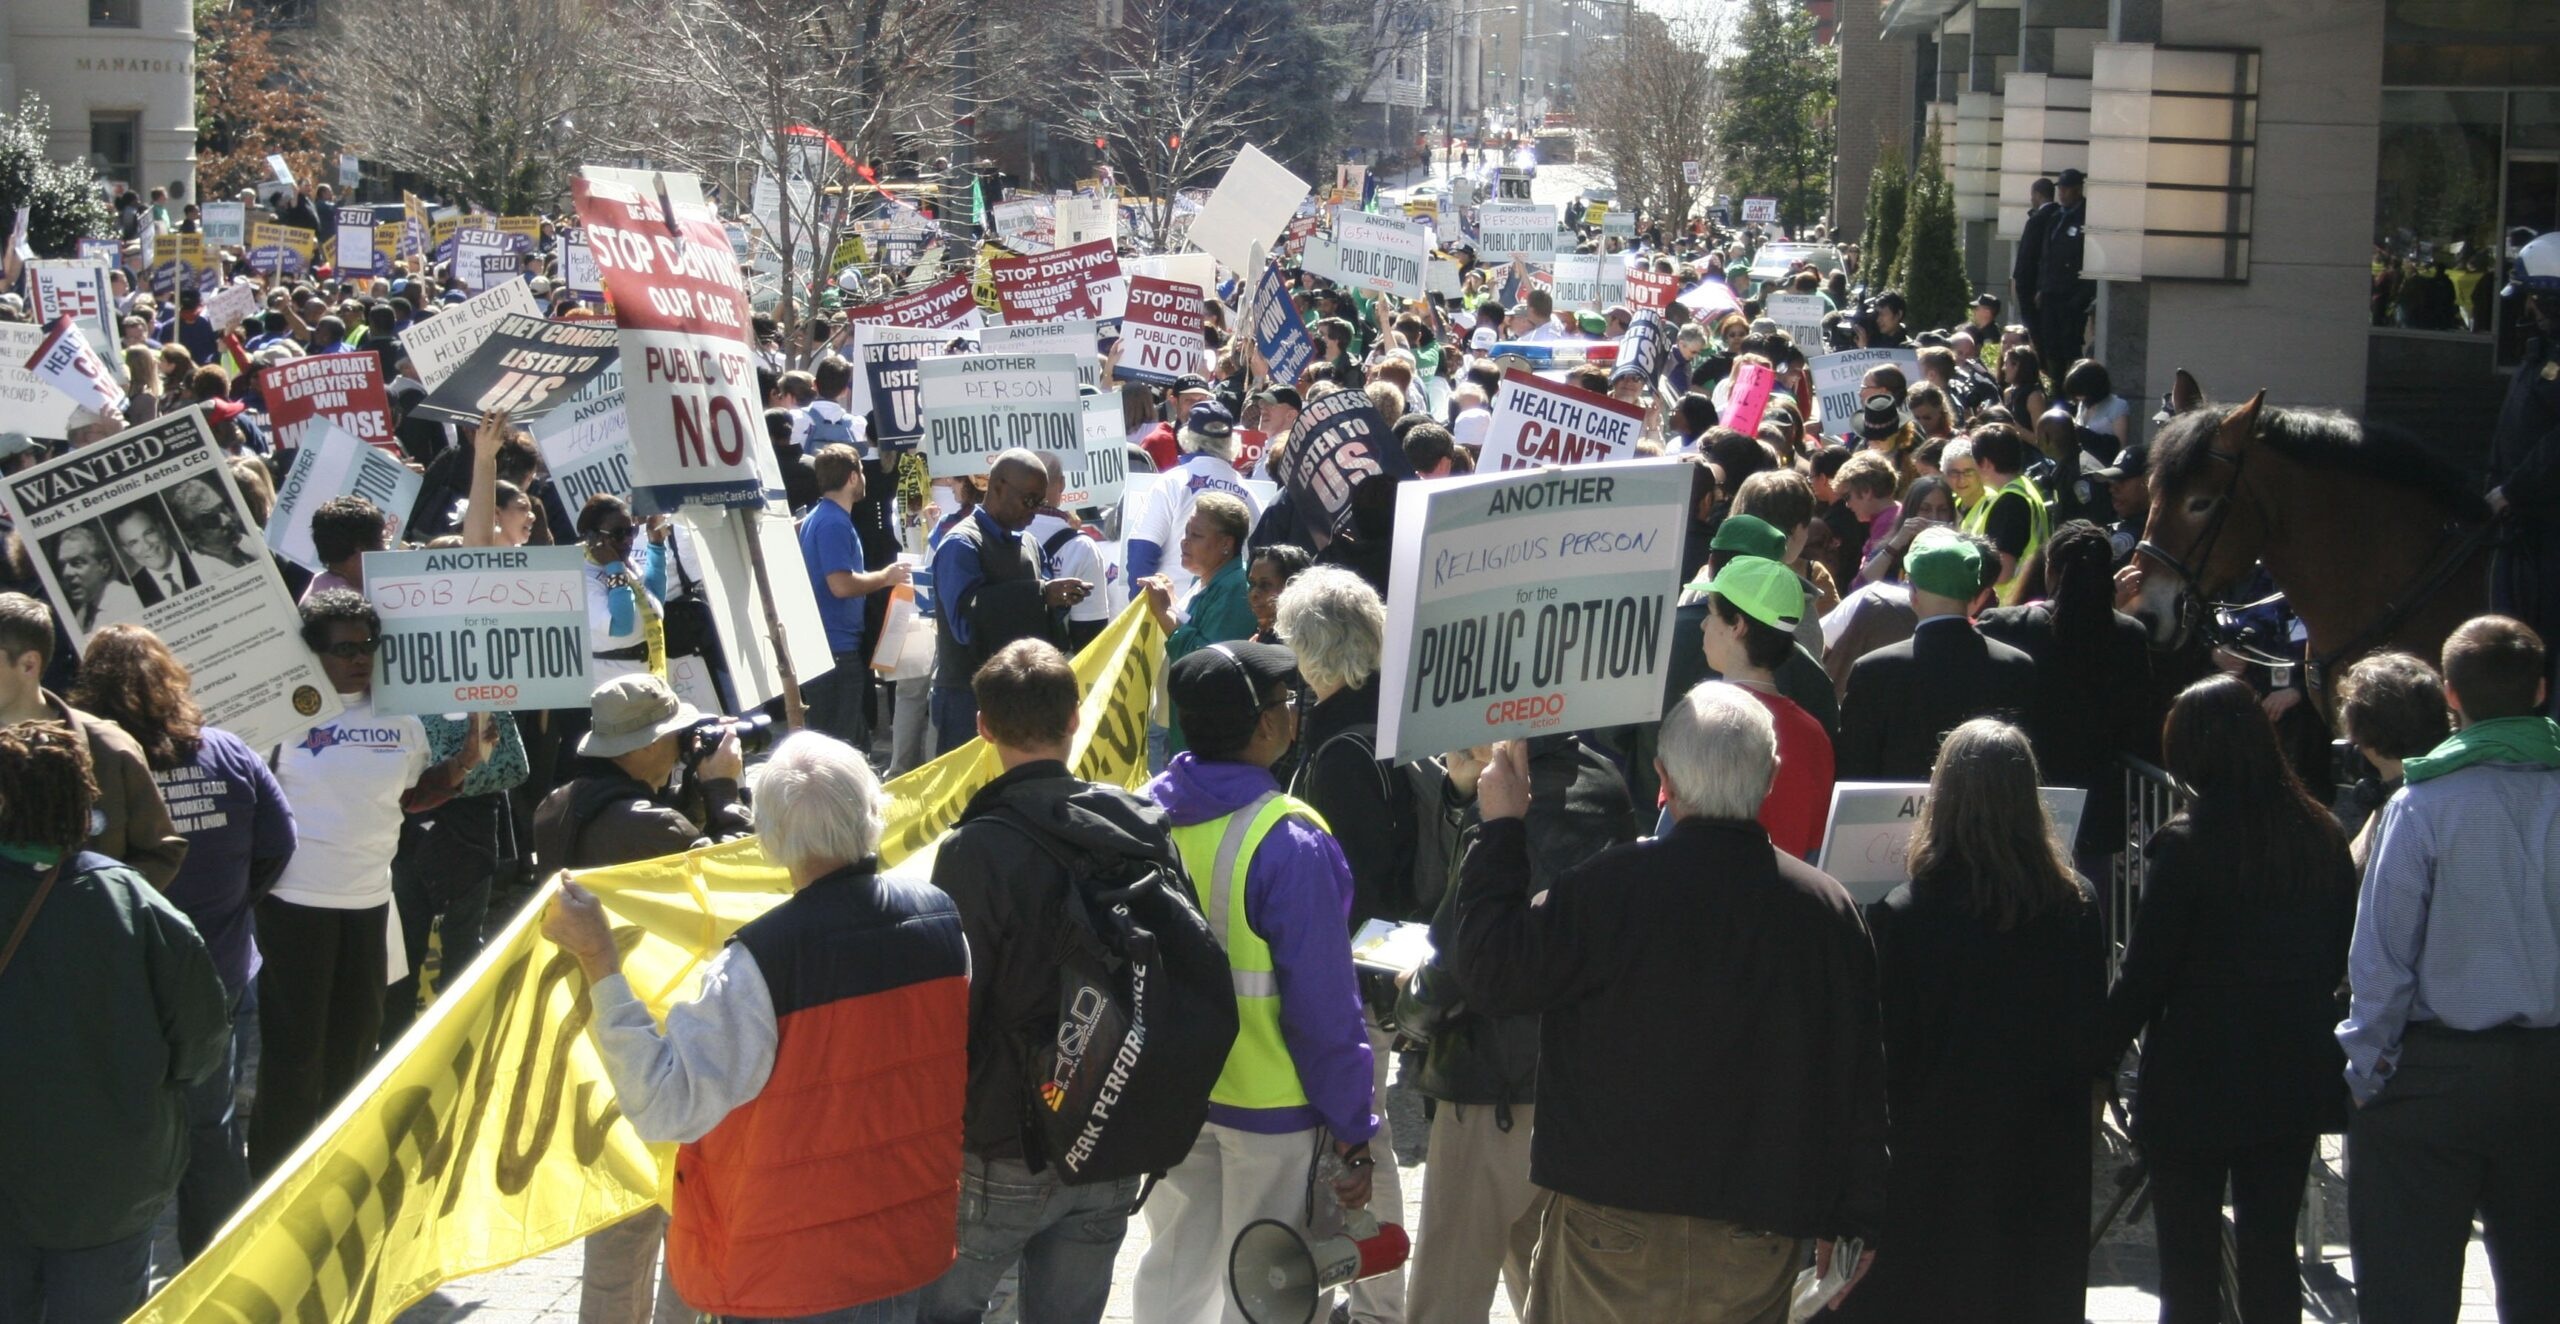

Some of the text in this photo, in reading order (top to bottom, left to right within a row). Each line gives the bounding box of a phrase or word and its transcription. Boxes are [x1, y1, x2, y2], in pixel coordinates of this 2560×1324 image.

[339, 211, 372, 225] SEIU
[1365, 216, 1405, 231] ANOTHER
[460, 230, 502, 246] SEIU
[569, 231, 588, 245] SE
[587, 223, 655, 275] STOP
[1483, 233, 1553, 252] PUBLIC OPTION
[484, 257, 516, 271] SEIU
[995, 250, 1114, 282] STOP DENYING
[1341, 248, 1419, 286] PUBLIC OPTION
[1003, 291, 1013, 300] IF
[1014, 280, 1078, 300] CORPORATE
[1644, 271, 1672, 285] TO US
[41, 276, 57, 313] CARE
[1013, 291, 1072, 309] LOBBYISTS
[1131, 289, 1173, 308] STOP
[1556, 282, 1587, 301] PUBLIC
[1589, 284, 1623, 302] OTION
[1626, 281, 1661, 306] NOT
[648, 287, 740, 328] OUR CARE
[852, 312, 894, 327] STOP
[893, 284, 968, 324] DENYING
[1032, 305, 1056, 317] WIN
[405, 320, 447, 350] FIGHT
[448, 310, 468, 327] THE
[470, 288, 511, 319] GREED
[497, 314, 620, 348] HEY CONGRE
[1153, 311, 1201, 329] OUR CARE
[1260, 296, 1286, 344] NOW
[1010, 325, 1065, 339] ANOTHER
[1134, 328, 1177, 345] PUBLIC
[1795, 325, 1821, 345] OPTION
[434, 335, 467, 363] HELP
[499, 348, 600, 374] LISTEN TO
[863, 344, 885, 363] HEY
[1140, 344, 1200, 374] NOW
[1840, 350, 1892, 363] ANOTHER
[266, 356, 375, 389] IF CORPORATE
[645, 346, 716, 386] PUBLIC
[962, 357, 1036, 372] ANOTHER
[283, 373, 368, 401] LOBBYISTS
[880, 370, 920, 388] LISTE
[964, 375, 1052, 399] PERSON
[312, 391, 348, 410] WIN
[477, 371, 566, 414] US
[574, 392, 626, 422] ANOTH
[1509, 388, 1631, 446] HEALTH CARE
[932, 412, 1077, 456] PUBLIC OPTION
[1279, 391, 1374, 487] HEY CONGRESS
[1516, 420, 1612, 466] CAN'T
[1298, 418, 1370, 490] LISTEN TO
[15, 435, 164, 508] WANTED
[280, 449, 317, 515] ANOTHER
[352, 452, 402, 507] PTION
[1311, 441, 1383, 514] US
[31, 450, 210, 528] Mark T. Bertolini: Aetna CEO
[1061, 491, 1089, 503] REDO
[1207, 478, 1249, 498] ACTION
[1488, 476, 1615, 517] ANOTHER
[425, 552, 529, 572] ANOTHER
[1433, 528, 1658, 589] RELIGIOUS PERSON
[142, 585, 216, 620] CRIMINAL RECORD
[378, 575, 577, 612] JOB LOSER
[1516, 586, 1558, 604] for the
[464, 616, 499, 627] for the
[381, 626, 583, 687] PUBLIC OPTION
[1412, 594, 1664, 714] PUBLIC OPTION
[454, 684, 518, 701] CREDO
[1485, 692, 1566, 726] CREDO
[1530, 716, 1561, 730] action
[307, 727, 401, 749] US ACTION
[172, 766, 206, 782] FOR ALL
[167, 781, 228, 797] MIDDLE CLASS
[172, 798, 216, 816] WORKERS
[192, 813, 228, 831] A UNION
[1065, 1116, 1104, 1173] PEAK
